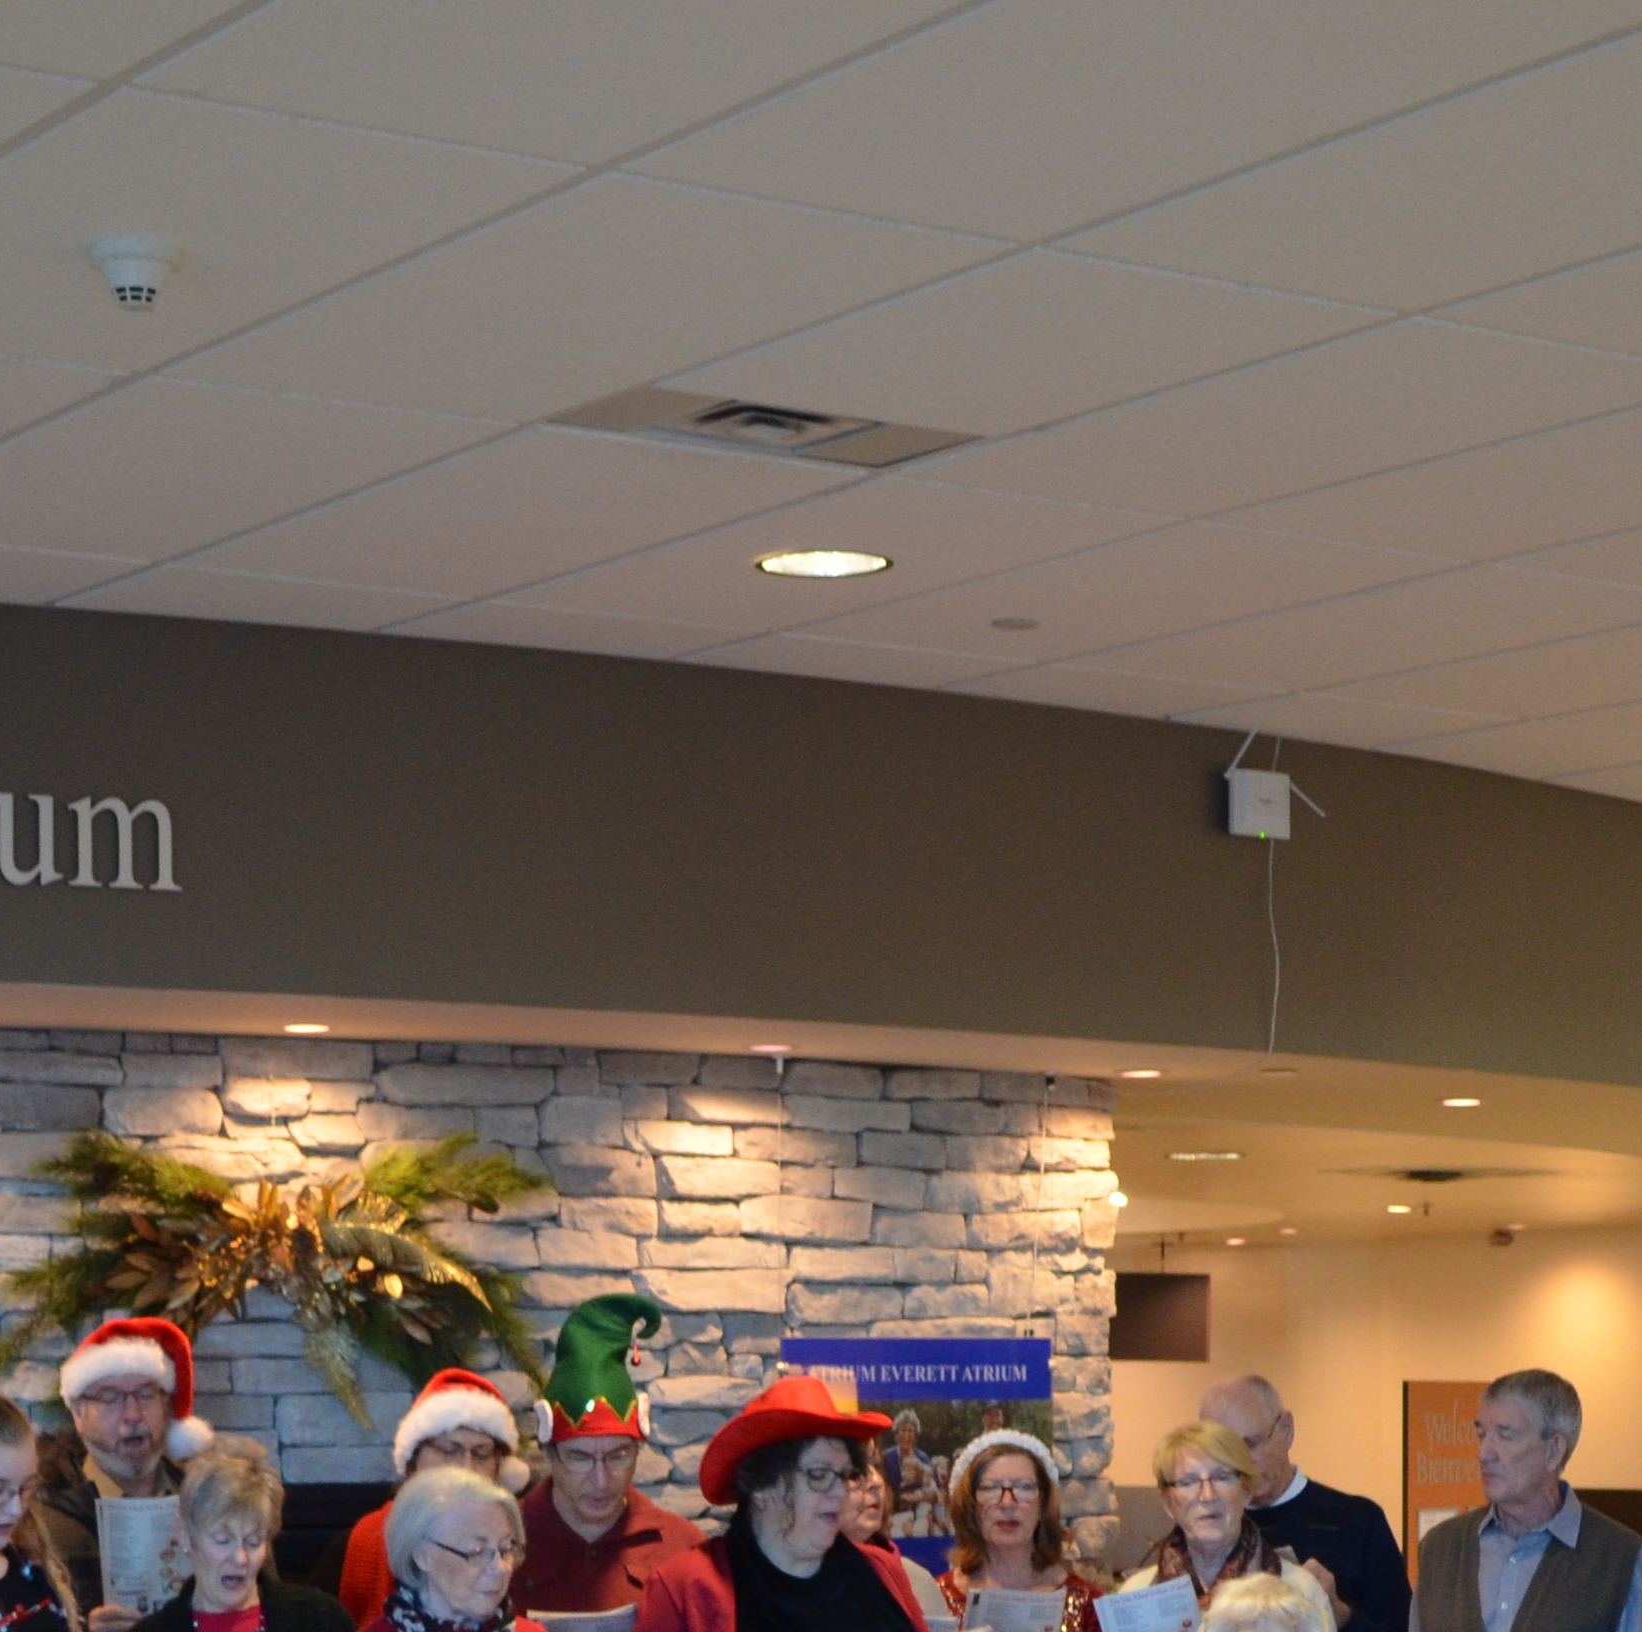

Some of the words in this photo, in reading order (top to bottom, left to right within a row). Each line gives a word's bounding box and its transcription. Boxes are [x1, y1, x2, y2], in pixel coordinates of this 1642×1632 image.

[808, 1364, 876, 1383] ATRIUM
[879, 1364, 960, 1383] EVERETT
[962, 1364, 1028, 1383] ATRIUM
